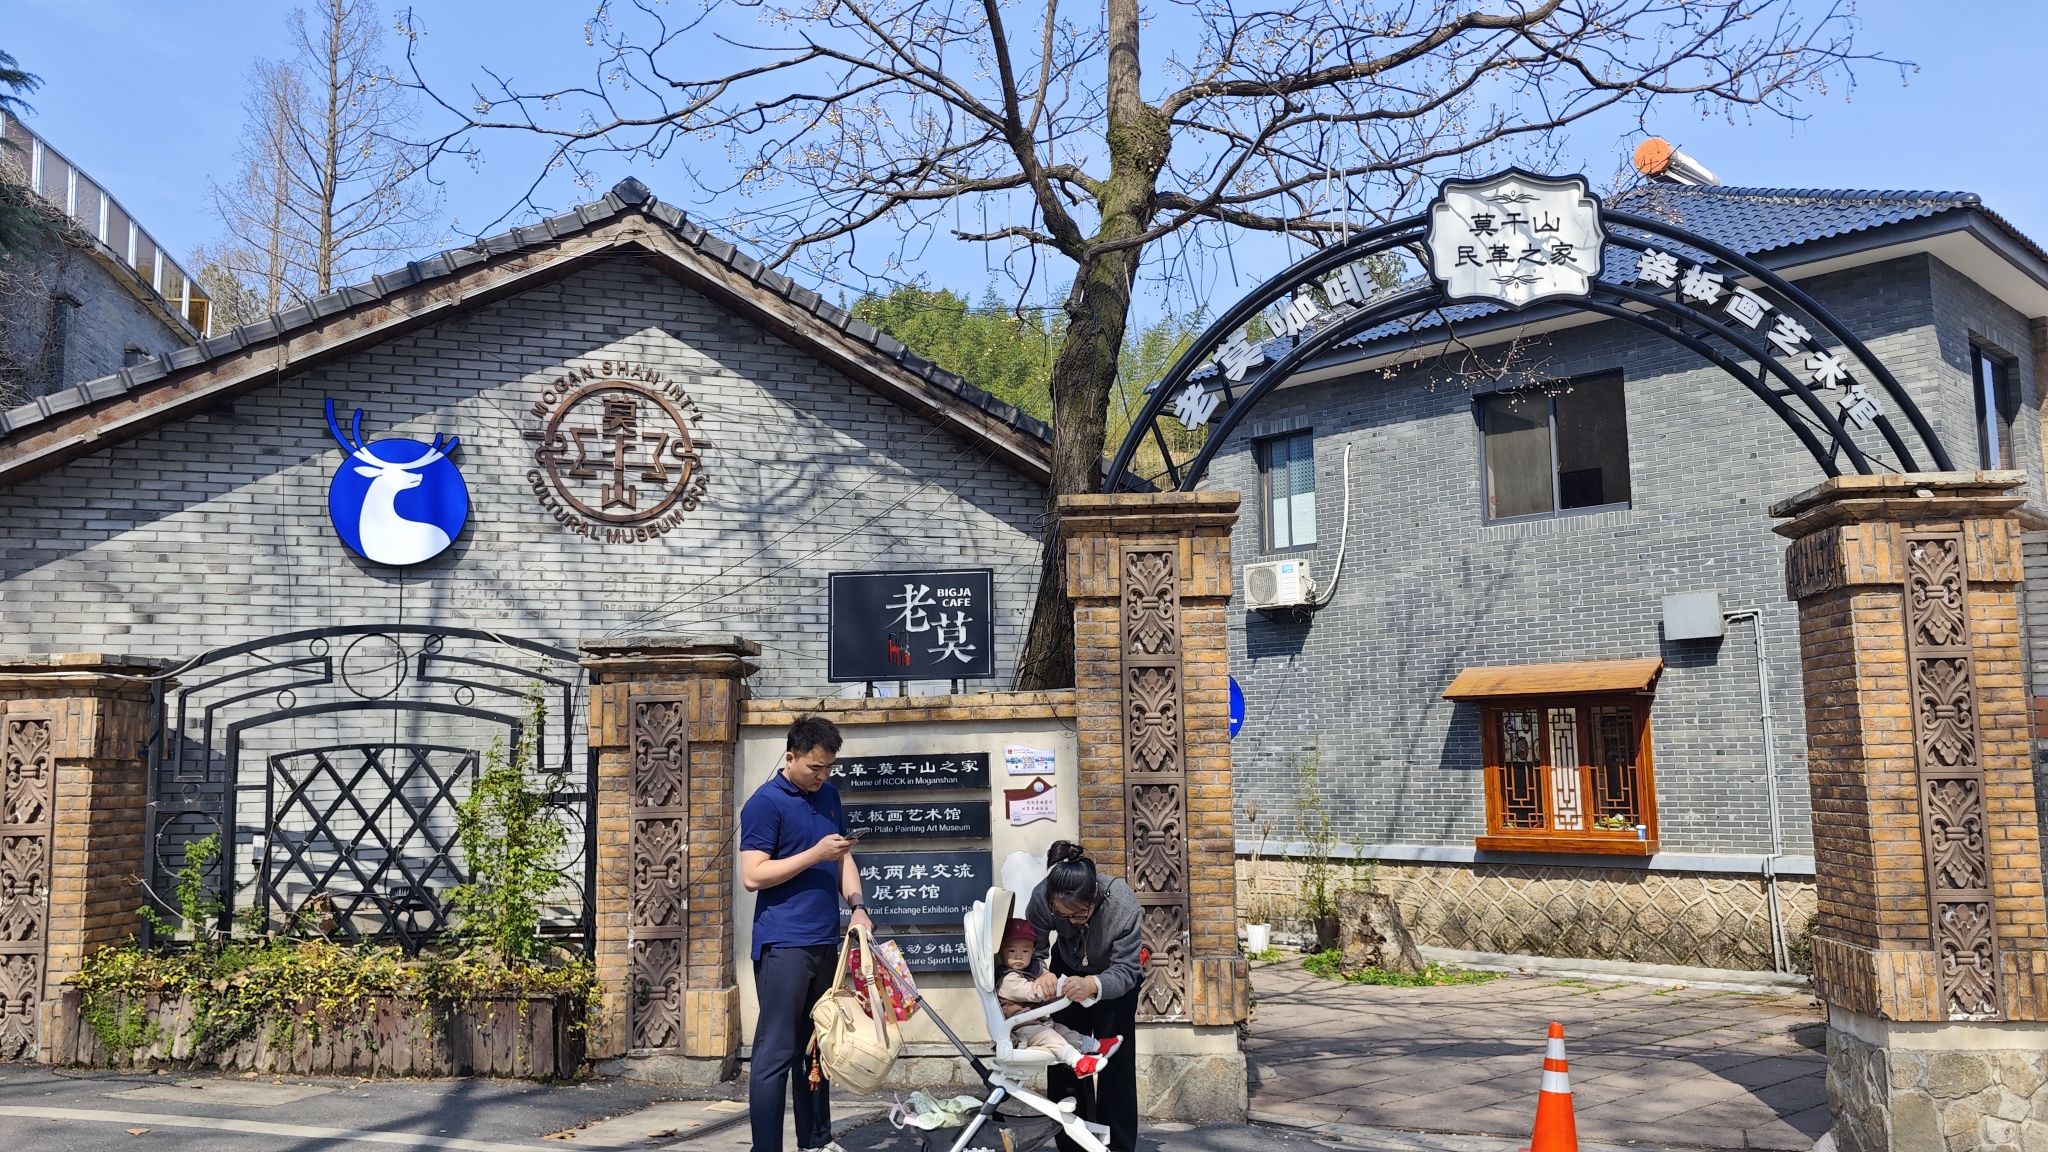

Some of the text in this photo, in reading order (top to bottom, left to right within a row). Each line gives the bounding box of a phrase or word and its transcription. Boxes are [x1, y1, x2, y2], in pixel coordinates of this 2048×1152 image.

[1469, 211, 1560, 236] 莫干山
[1455, 242, 1577, 267] 民革之家
[1173, 262, 1380, 431] 老莫咖啡
[1636, 248, 1885, 430] 瓷板画艺术馆
[530, 364, 594, 419] MOGAN
[602, 361, 661, 385] SHAN
[526, 469, 600, 541] CULTURAL
[606, 508, 685, 544] MUSEUM
[937, 587, 971, 597] BIGJA
[942, 598, 971, 607] CAFE
[882, 584, 978, 666] 老莫
[883, 778, 906, 786] RCCK
[915, 776, 958, 786] Moganshan
[848, 807, 961, 823] 瓷板画艺术馆
[874, 825, 894, 833] Plate
[895, 824, 925, 834] Painting
[926, 824, 938, 832] Art
[939, 823, 971, 832] Museum
[872, 884, 940, 900] 展示馆
[884, 906, 921, 916] Exchange
[922, 905, 959, 914] Exhibition
[927, 956, 950, 966] Sport
